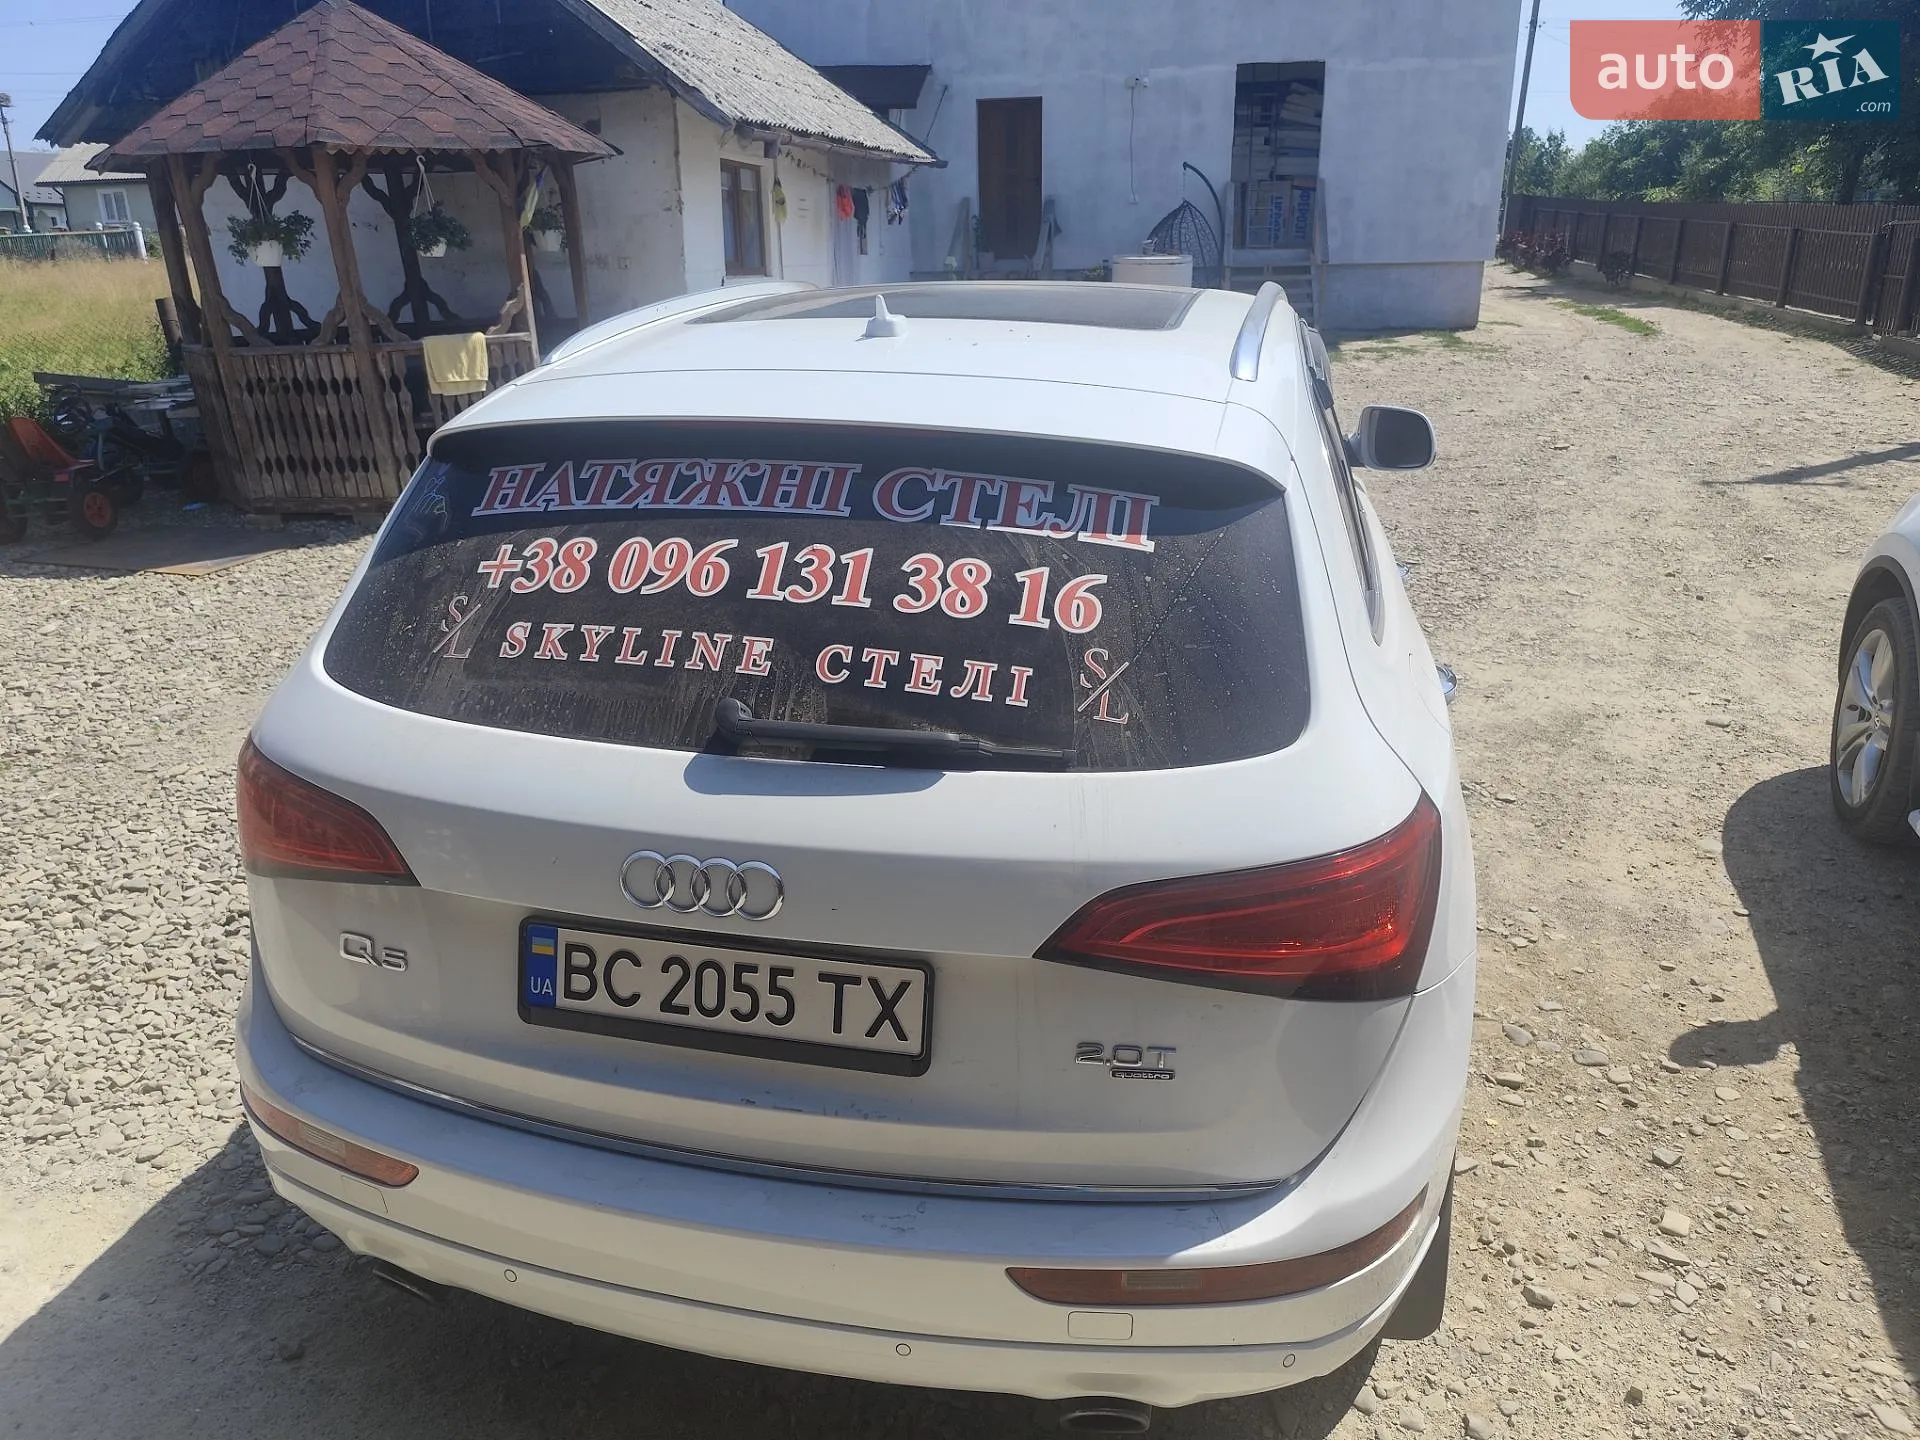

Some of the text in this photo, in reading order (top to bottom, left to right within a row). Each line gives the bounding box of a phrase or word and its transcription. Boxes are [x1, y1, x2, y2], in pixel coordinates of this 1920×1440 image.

[471, 457, 1160, 553] НАТЯЖНІ СТЕЛІ
[477, 536, 1108, 634] +38 096 131 38 16
[499, 621, 1033, 708] SKYLINE СТЕЛІ
[338, 931, 408, 972] Q5
[530, 975, 553, 996] UA
[563, 942, 911, 1042] BC 2055 TX
[1075, 1042, 1176, 1068] 2.0T
[1113, 1069, 1172, 1080] quattro
